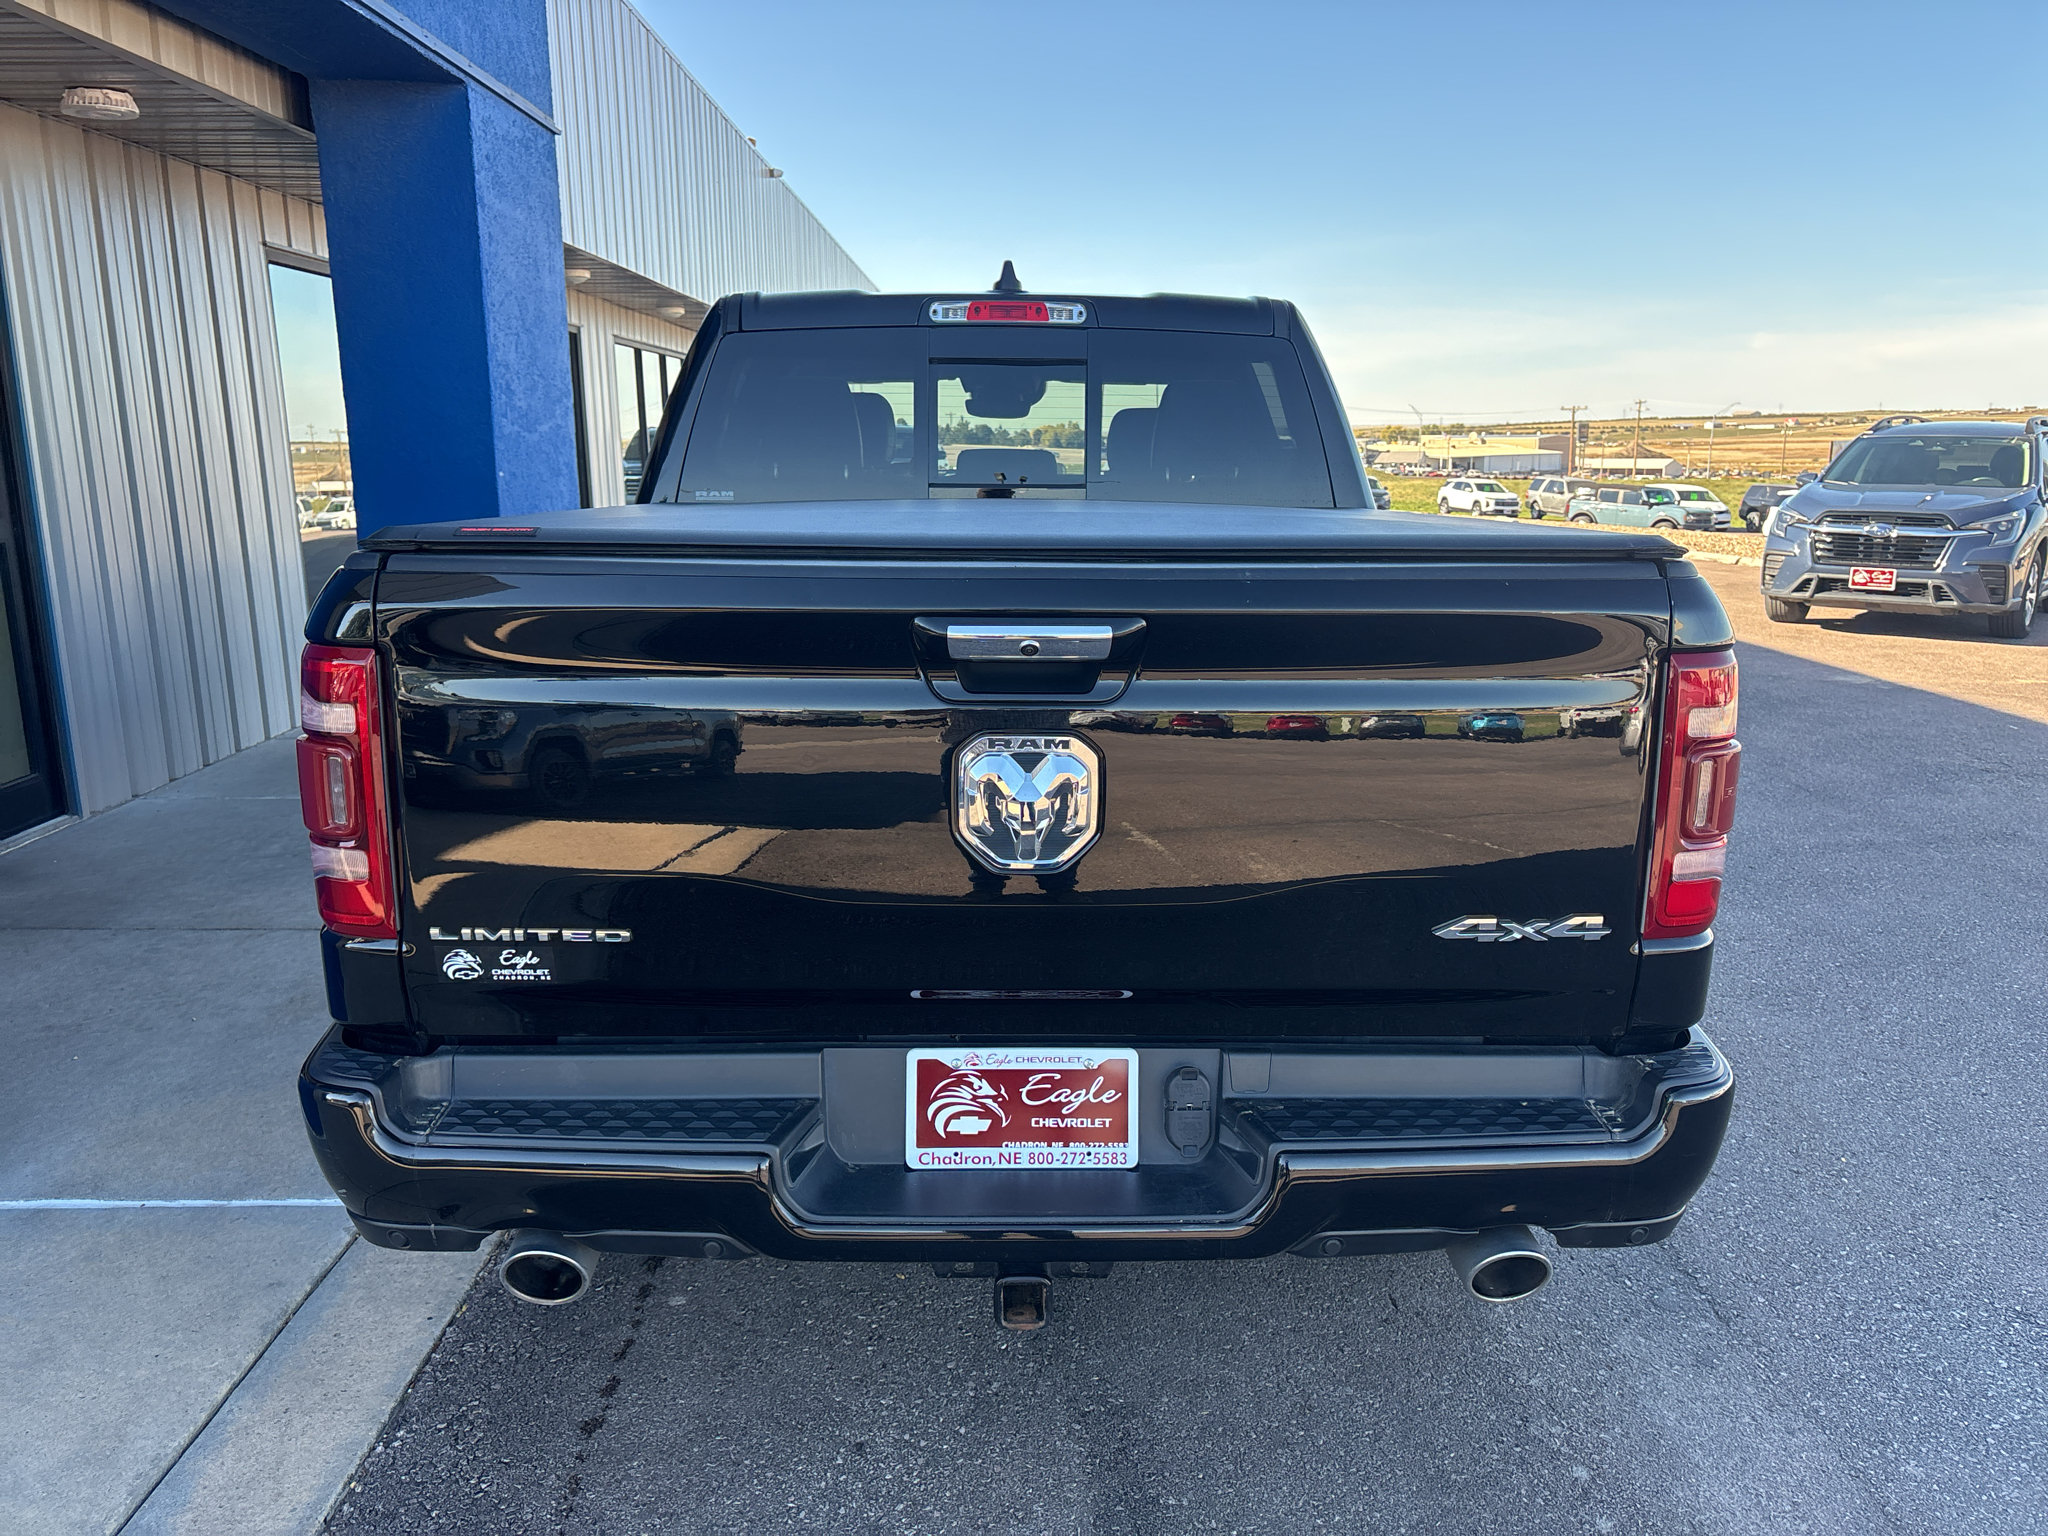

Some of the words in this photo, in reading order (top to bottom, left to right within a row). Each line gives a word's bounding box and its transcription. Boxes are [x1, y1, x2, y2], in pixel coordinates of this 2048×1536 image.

[988, 739, 1070, 750] RAM
[429, 926, 633, 943] LIMITED
[499, 949, 541, 969] Eagle
[491, 968, 550, 976] CHEVROLET
[985, 1053, 1014, 1068] Eagle
[1018, 1072, 1123, 1115] Eagle
[1030, 1117, 1113, 1128] CHEVROLET
[1028, 1152, 1128, 1165] 800-272-5583
